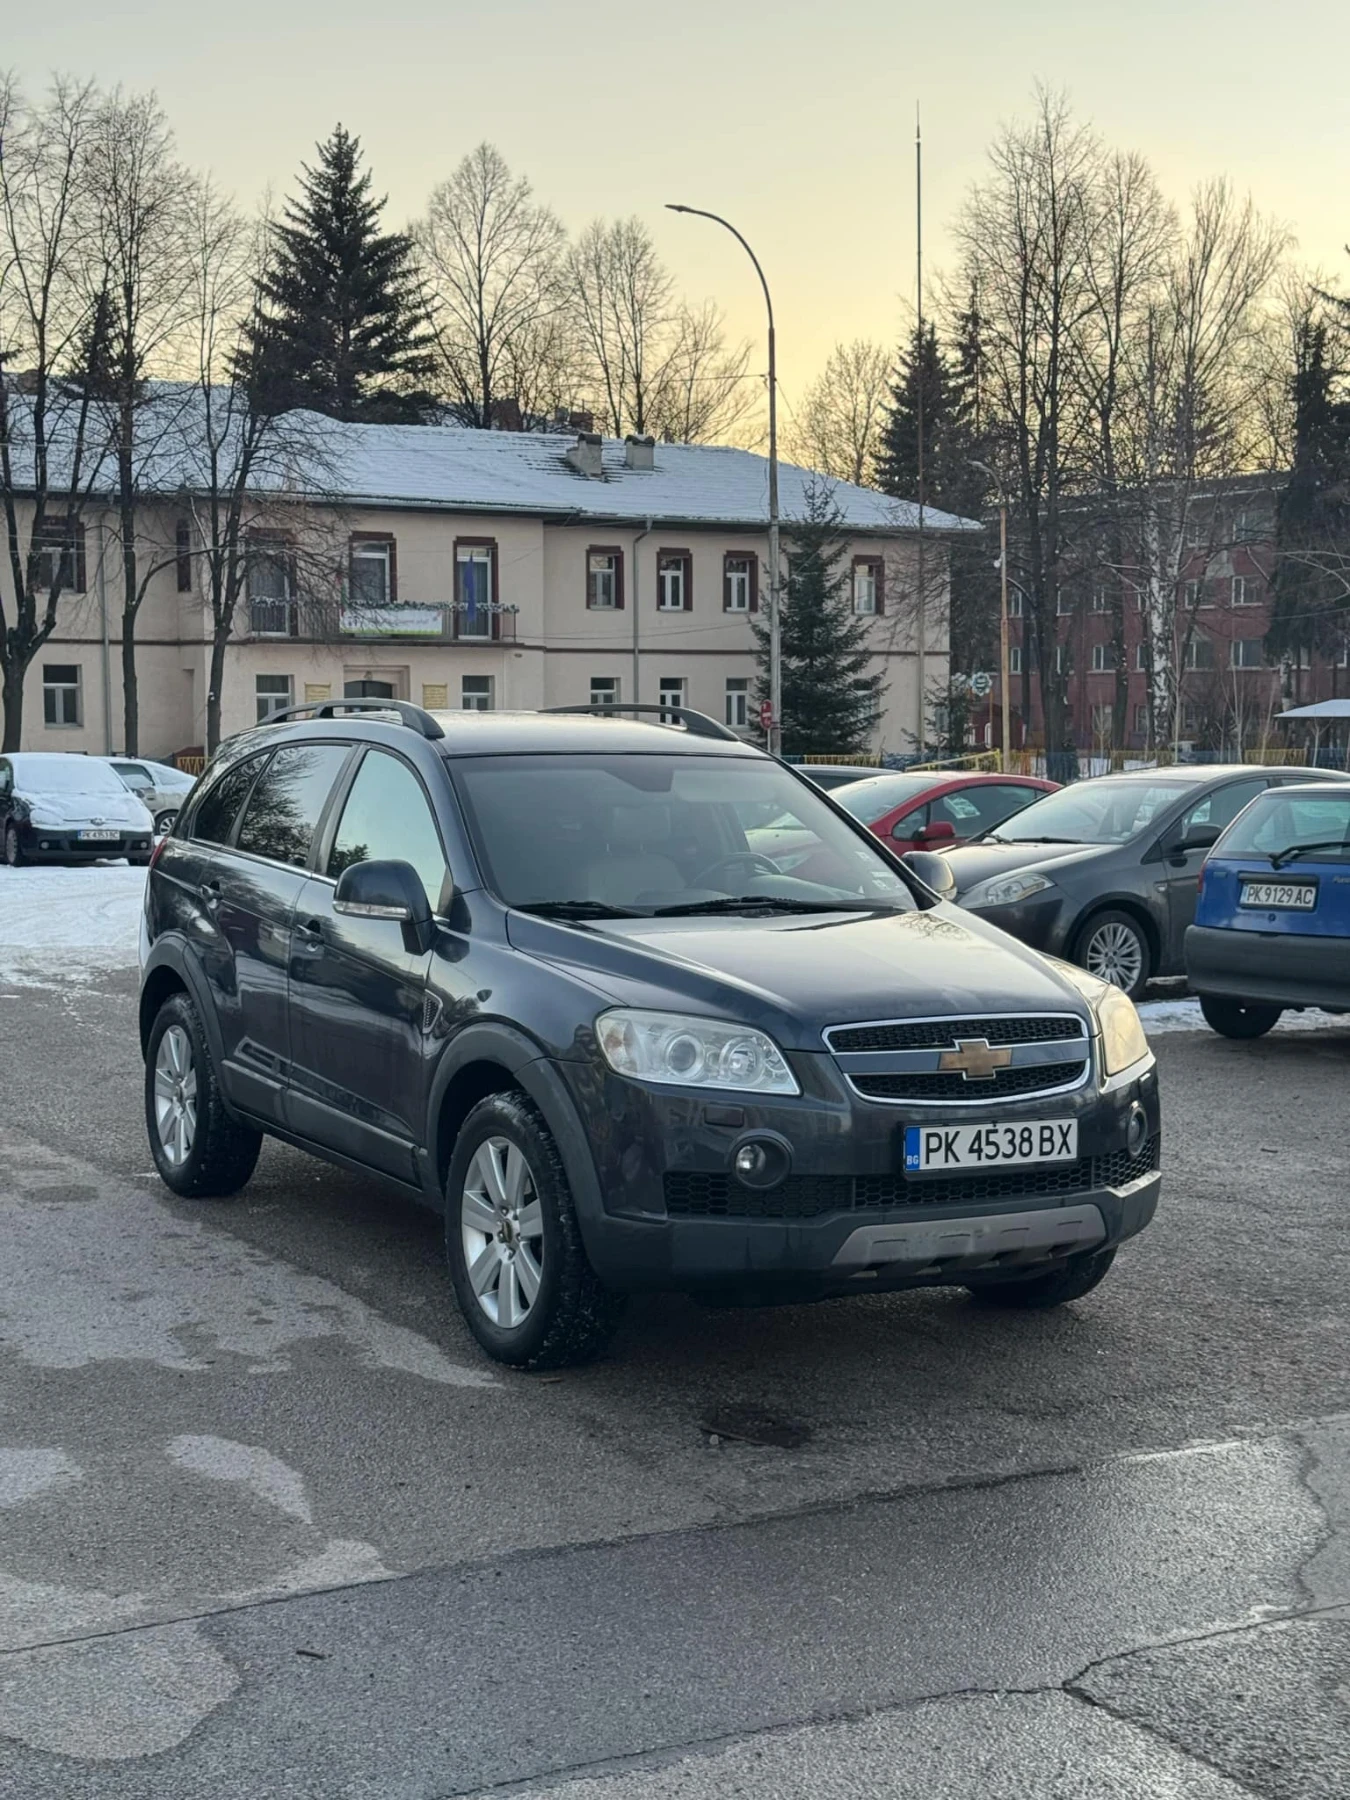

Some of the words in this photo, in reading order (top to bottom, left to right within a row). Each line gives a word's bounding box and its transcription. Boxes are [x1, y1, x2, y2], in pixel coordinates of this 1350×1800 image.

[1247, 886, 1263, 902] PK
[1265, 887, 1293, 903] 9129
[1294, 888, 1313, 904] AC
[924, 1130, 961, 1165] PK
[968, 1127, 1034, 1161] 4538
[1039, 1123, 1073, 1156] BX
[906, 1155, 919, 1165] BG
